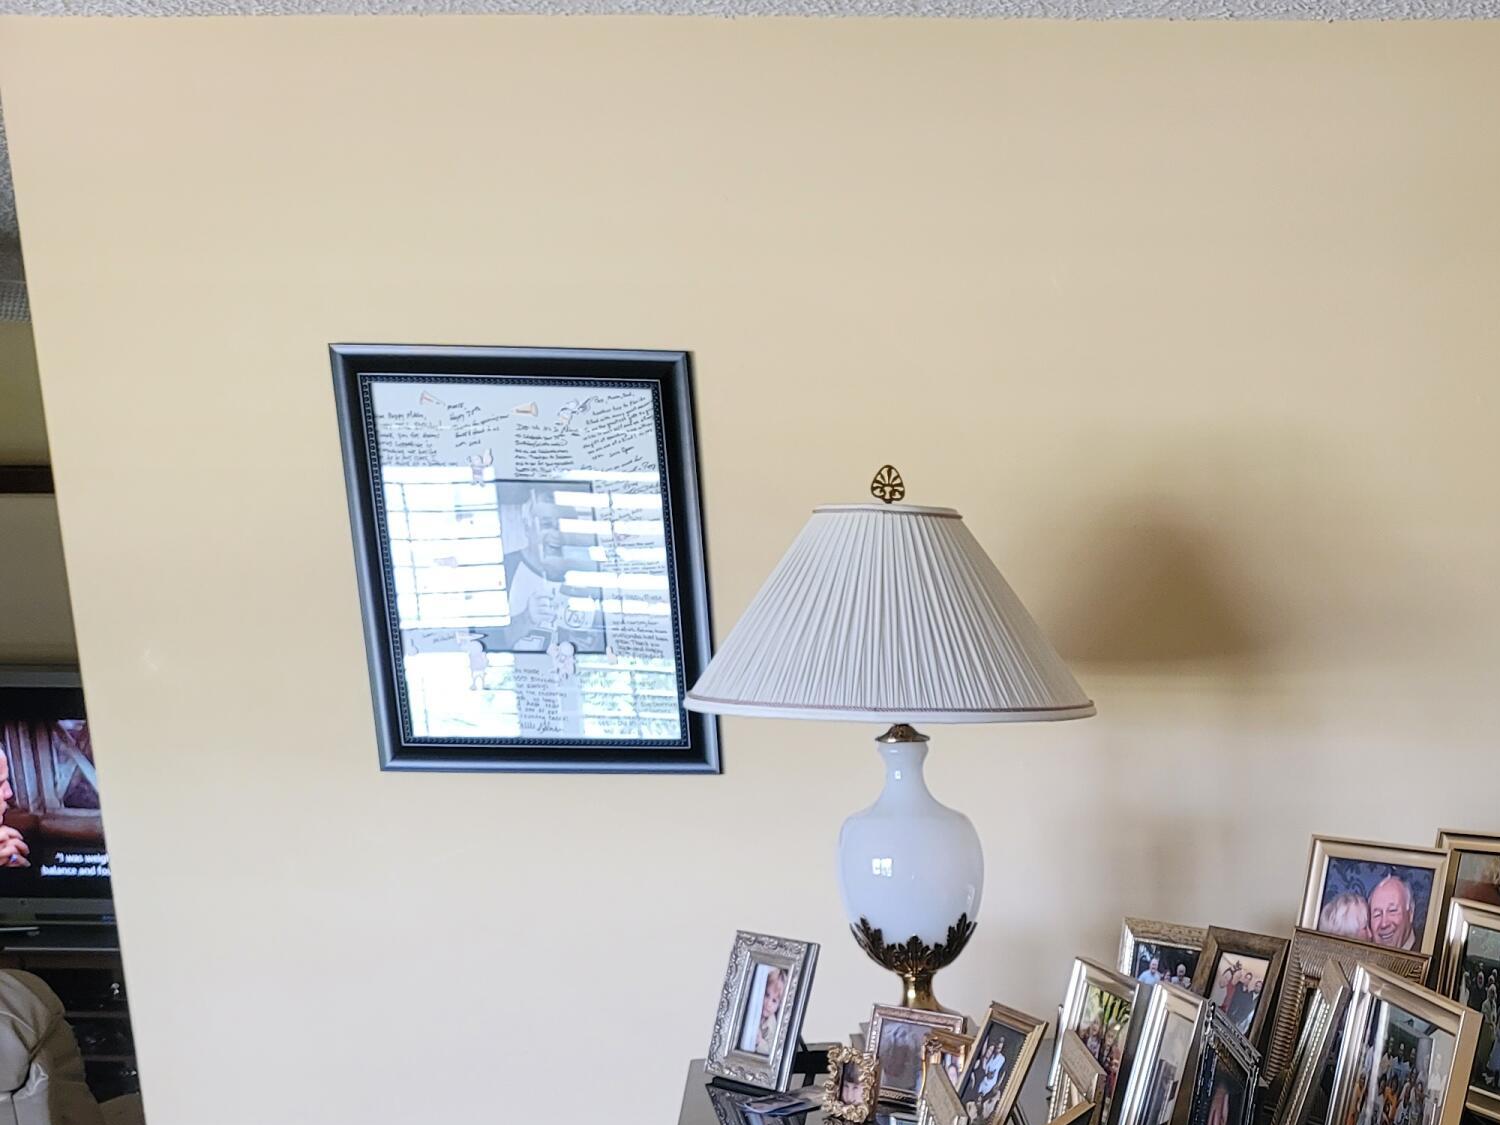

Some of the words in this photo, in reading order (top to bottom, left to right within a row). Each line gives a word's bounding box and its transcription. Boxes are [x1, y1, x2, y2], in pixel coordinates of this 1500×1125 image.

[65, 854, 84, 863] was
[40, 864, 78, 876] balance
[78, 865, 96, 876] and
